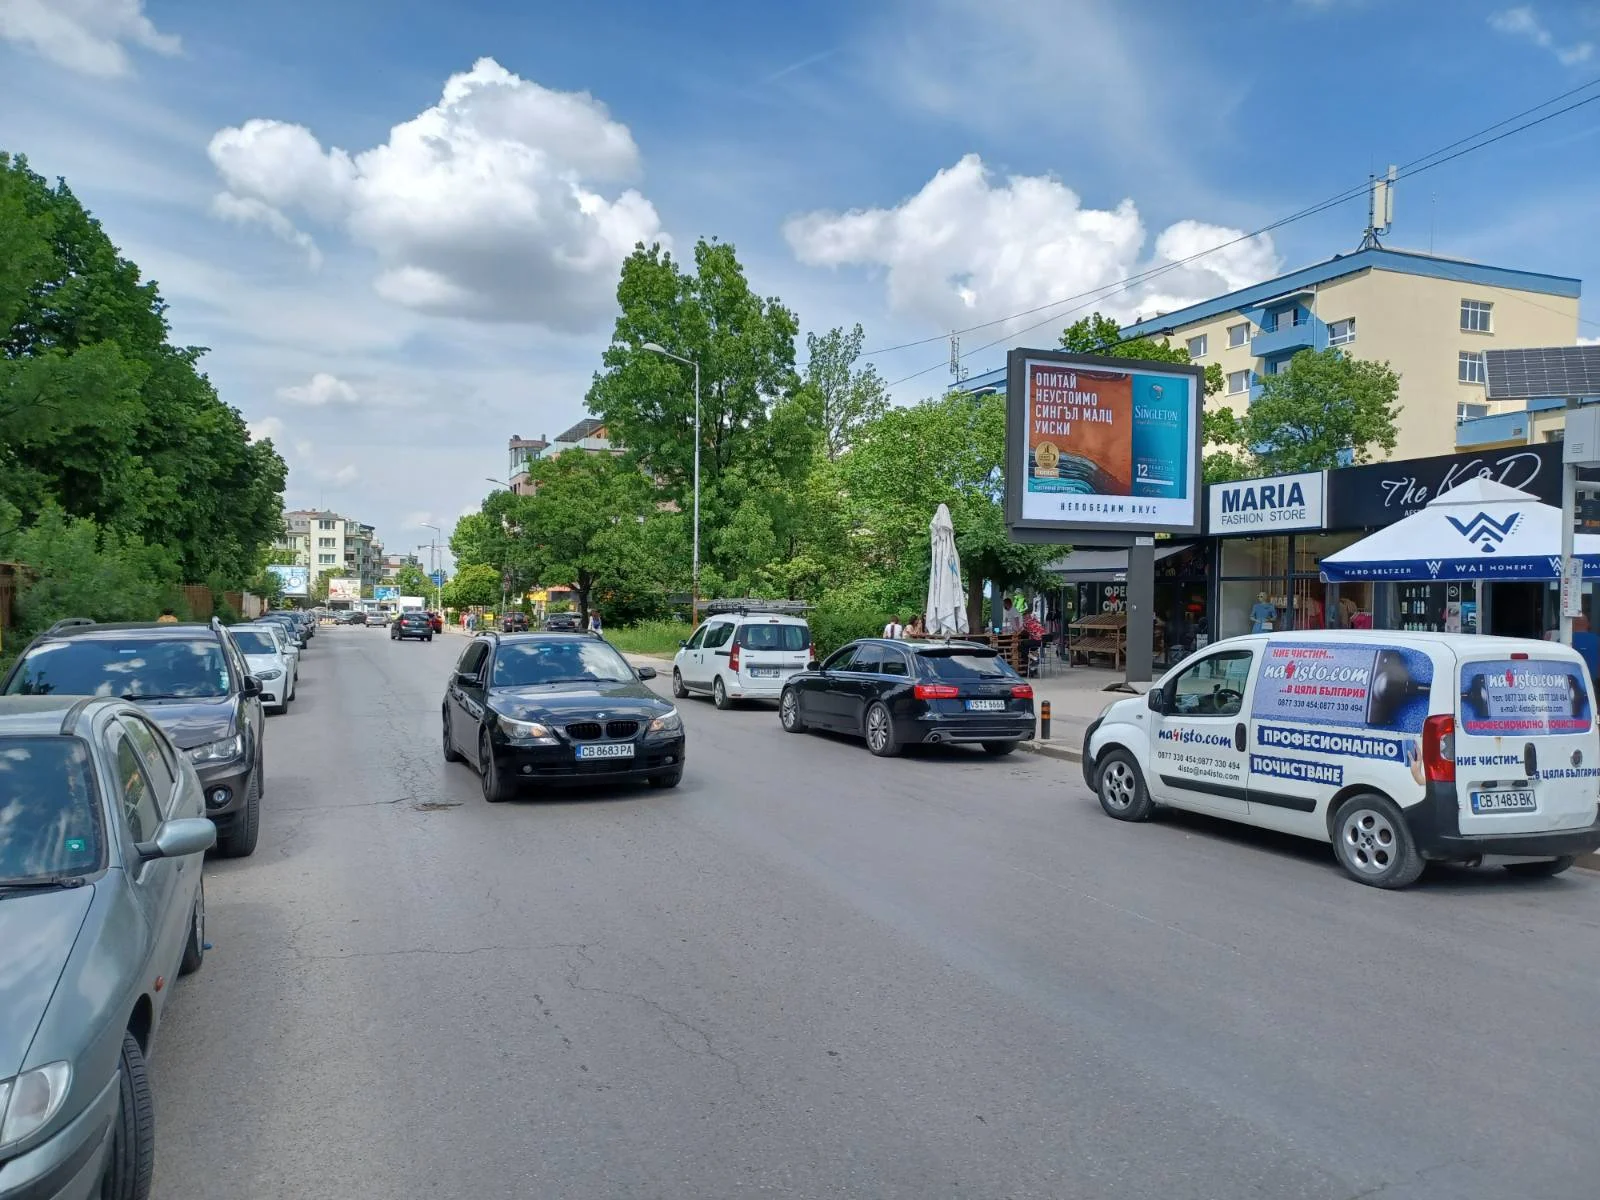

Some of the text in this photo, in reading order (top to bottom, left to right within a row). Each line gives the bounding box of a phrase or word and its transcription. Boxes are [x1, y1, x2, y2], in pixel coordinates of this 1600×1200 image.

[1036, 372, 1076, 389] ОПИТАЙ
[1036, 389, 1098, 406] НЕУСТОИМО
[1035, 404, 1113, 425] СИНГЪЛ МАЛЦ
[1034, 420, 1070, 436] УИСКИ
[1136, 464, 1148, 477] 12
[1222, 482, 1305, 514] MARIA
[1381, 476, 1428, 507] The
[1060, 502, 1157, 514] НЕПОБЕДИМ ВКУС
[1221, 508, 1306, 525] FASHION STORE
[1455, 564, 1483, 572] WAI
[1104, 586, 1128, 597] ФРЕ
[1272, 648, 1334, 659] НИЕ ЧИСТИМ...
[1264, 660, 1370, 685] na4isto.com
[1294, 686, 1317, 696] ЦЯЛА
[1319, 686, 1366, 699] БЪЛГАРИЯ
[1278, 698, 1292, 706] 0877
[1337, 703, 1349, 711] 330
[1351, 704, 1363, 712] 494
[1158, 728, 1232, 748] na4isto.com
[1264, 729, 1398, 757] ПРОФЕСИОНАЛНО
[596, 746, 619, 756] 8683
[1158, 751, 1172, 759] 0877
[1214, 760, 1226, 768] 330
[1228, 761, 1240, 770] 494
[1457, 756, 1476, 766] НИЕ
[1253, 758, 1341, 782] ПОЧИСТВАНЕ
[1542, 769, 1564, 780] ЦЯЛА
[1496, 793, 1519, 807] 1483
